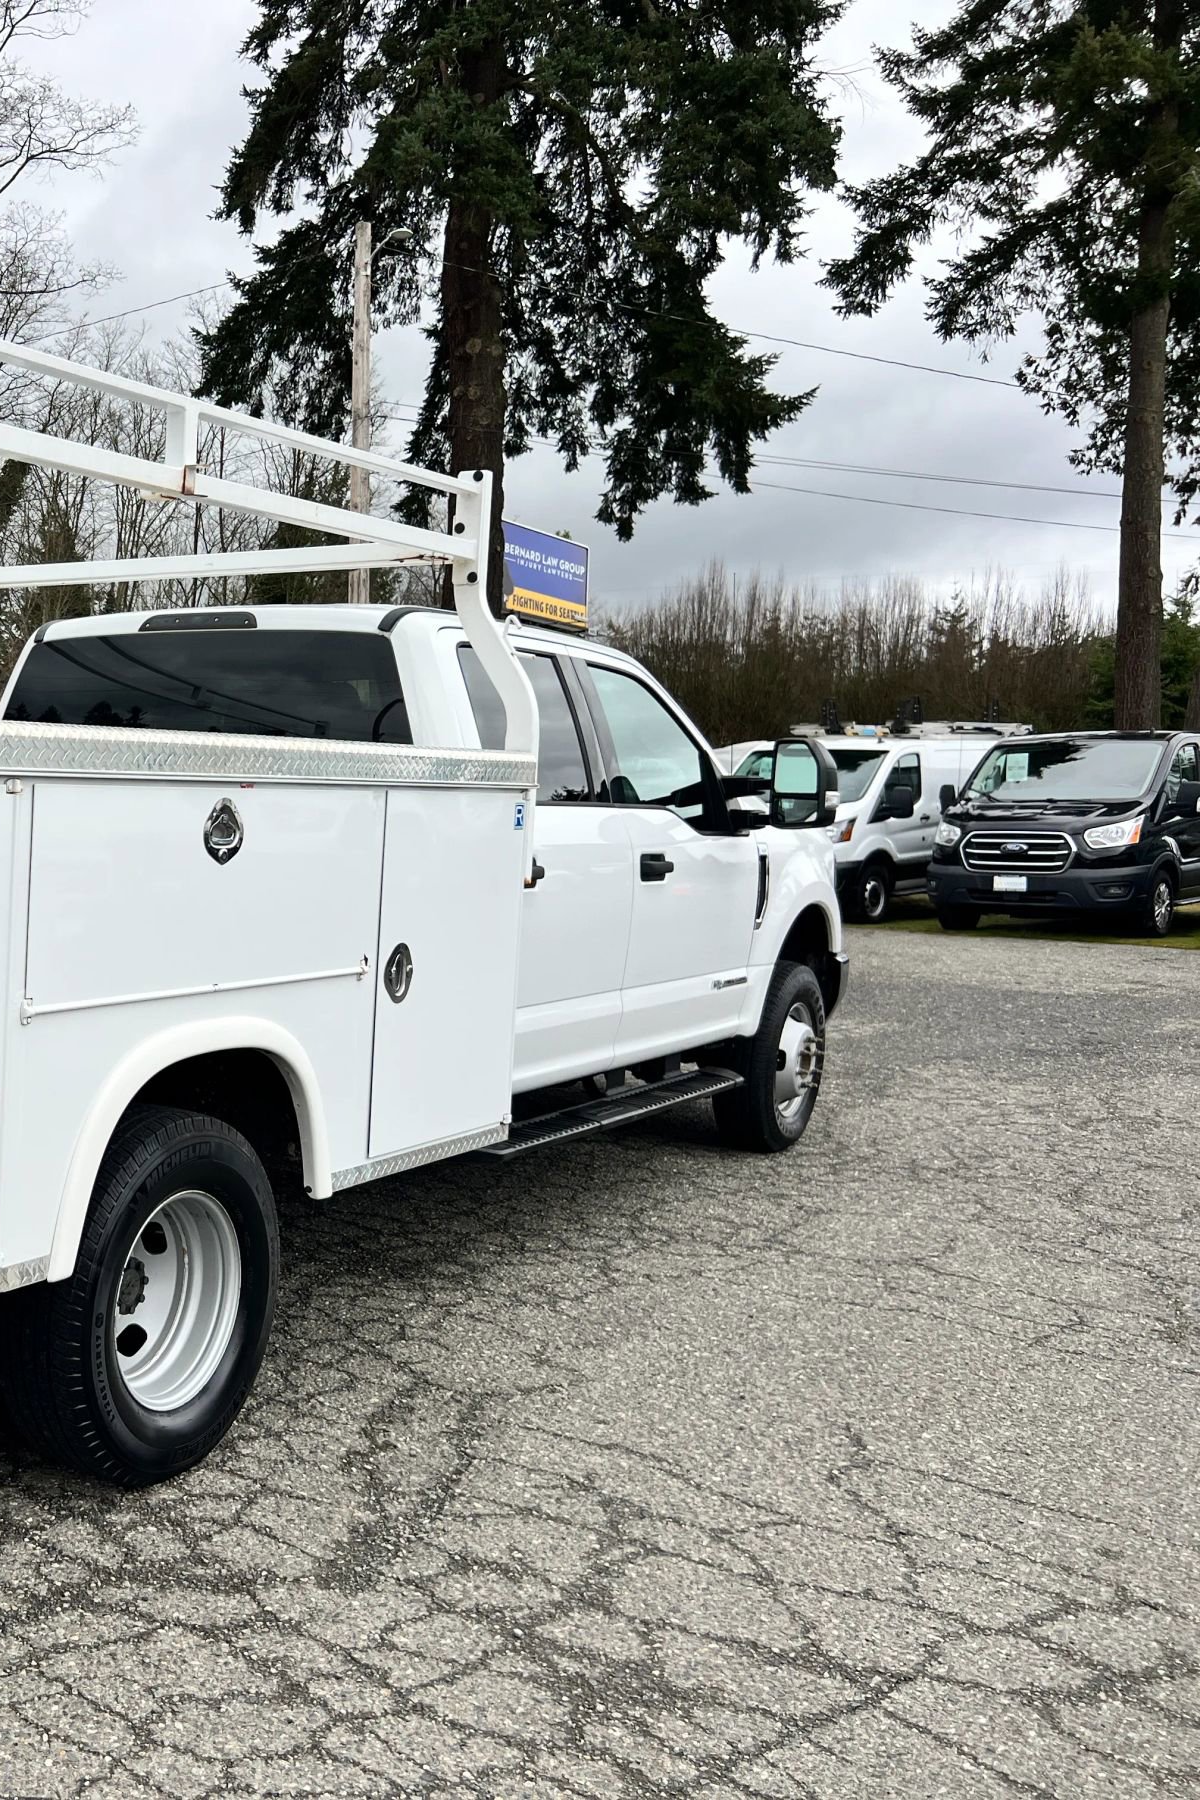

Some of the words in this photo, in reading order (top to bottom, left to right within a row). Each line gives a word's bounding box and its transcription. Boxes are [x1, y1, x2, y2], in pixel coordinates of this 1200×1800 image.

[504, 543, 541, 562] BERNARD
[542, 553, 559, 568] LAW
[559, 559, 585, 575] GROUP
[517, 558, 542, 571] INJURY
[543, 566, 573, 581] LAWYERS
[512, 594, 544, 613] FIGHTING
[545, 603, 558, 617] FOR
[144, 1141, 212, 1194] MICHELIN
